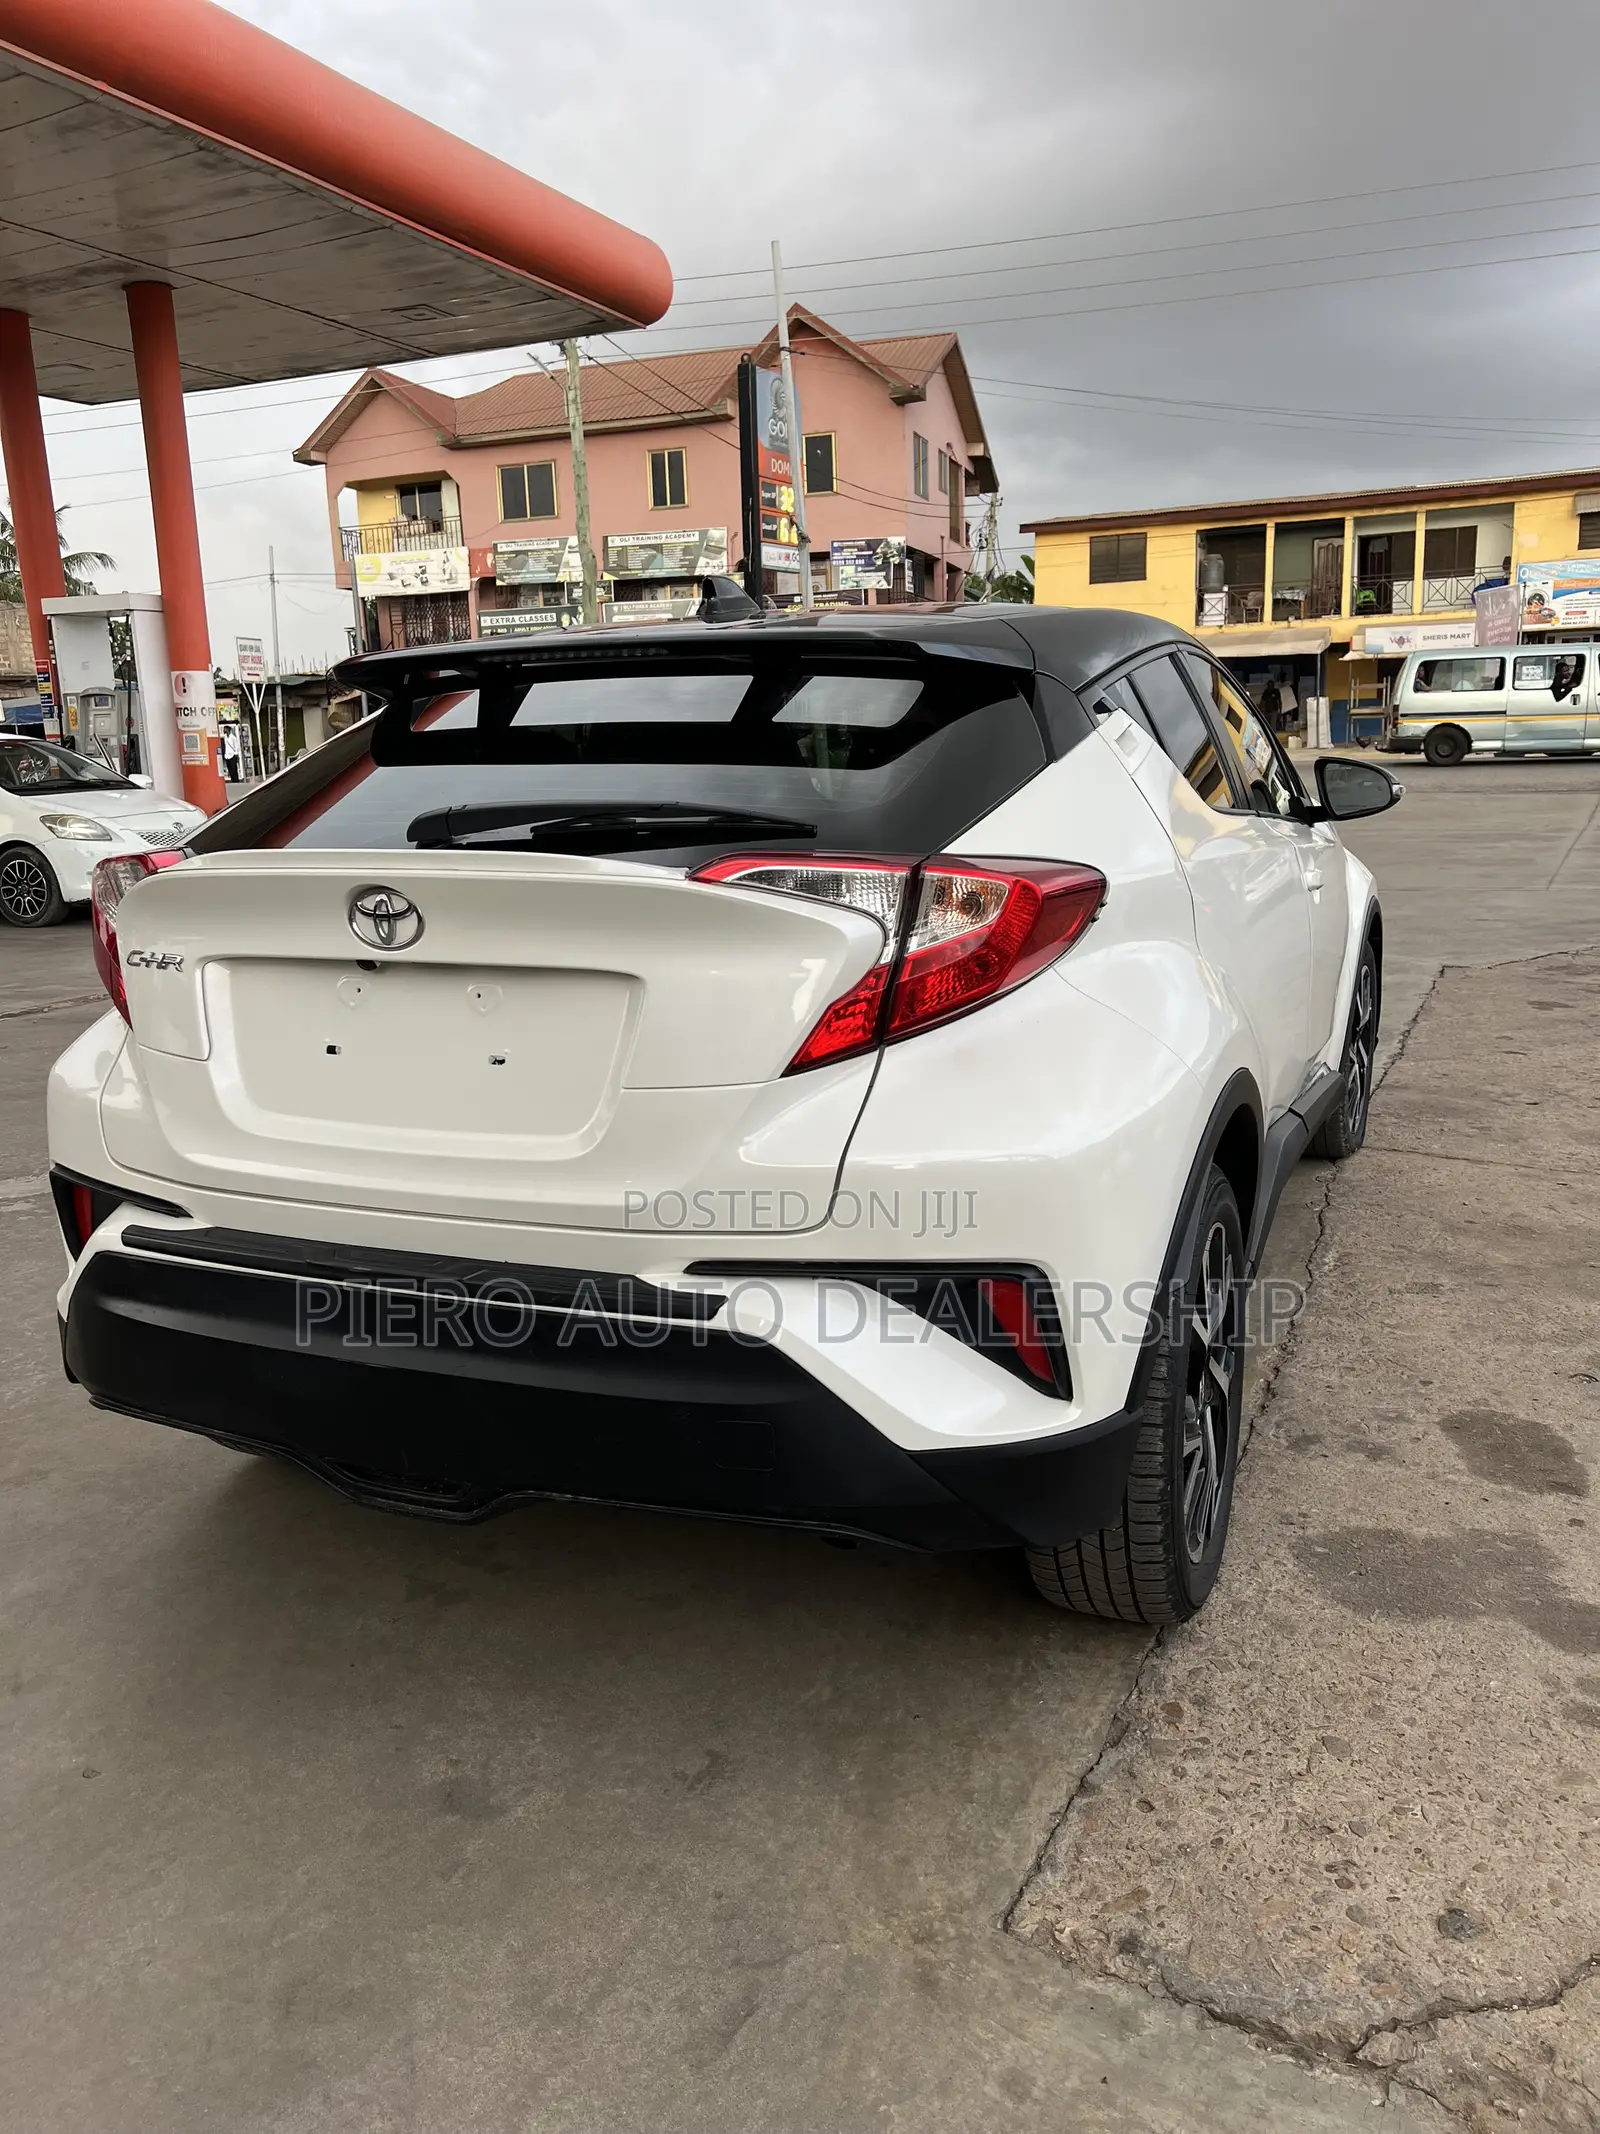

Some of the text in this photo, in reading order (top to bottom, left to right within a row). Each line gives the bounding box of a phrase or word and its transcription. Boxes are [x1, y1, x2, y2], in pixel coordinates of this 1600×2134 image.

[771, 458, 792, 475] DOM
[489, 614, 555, 625] EXTRA CLASSES
